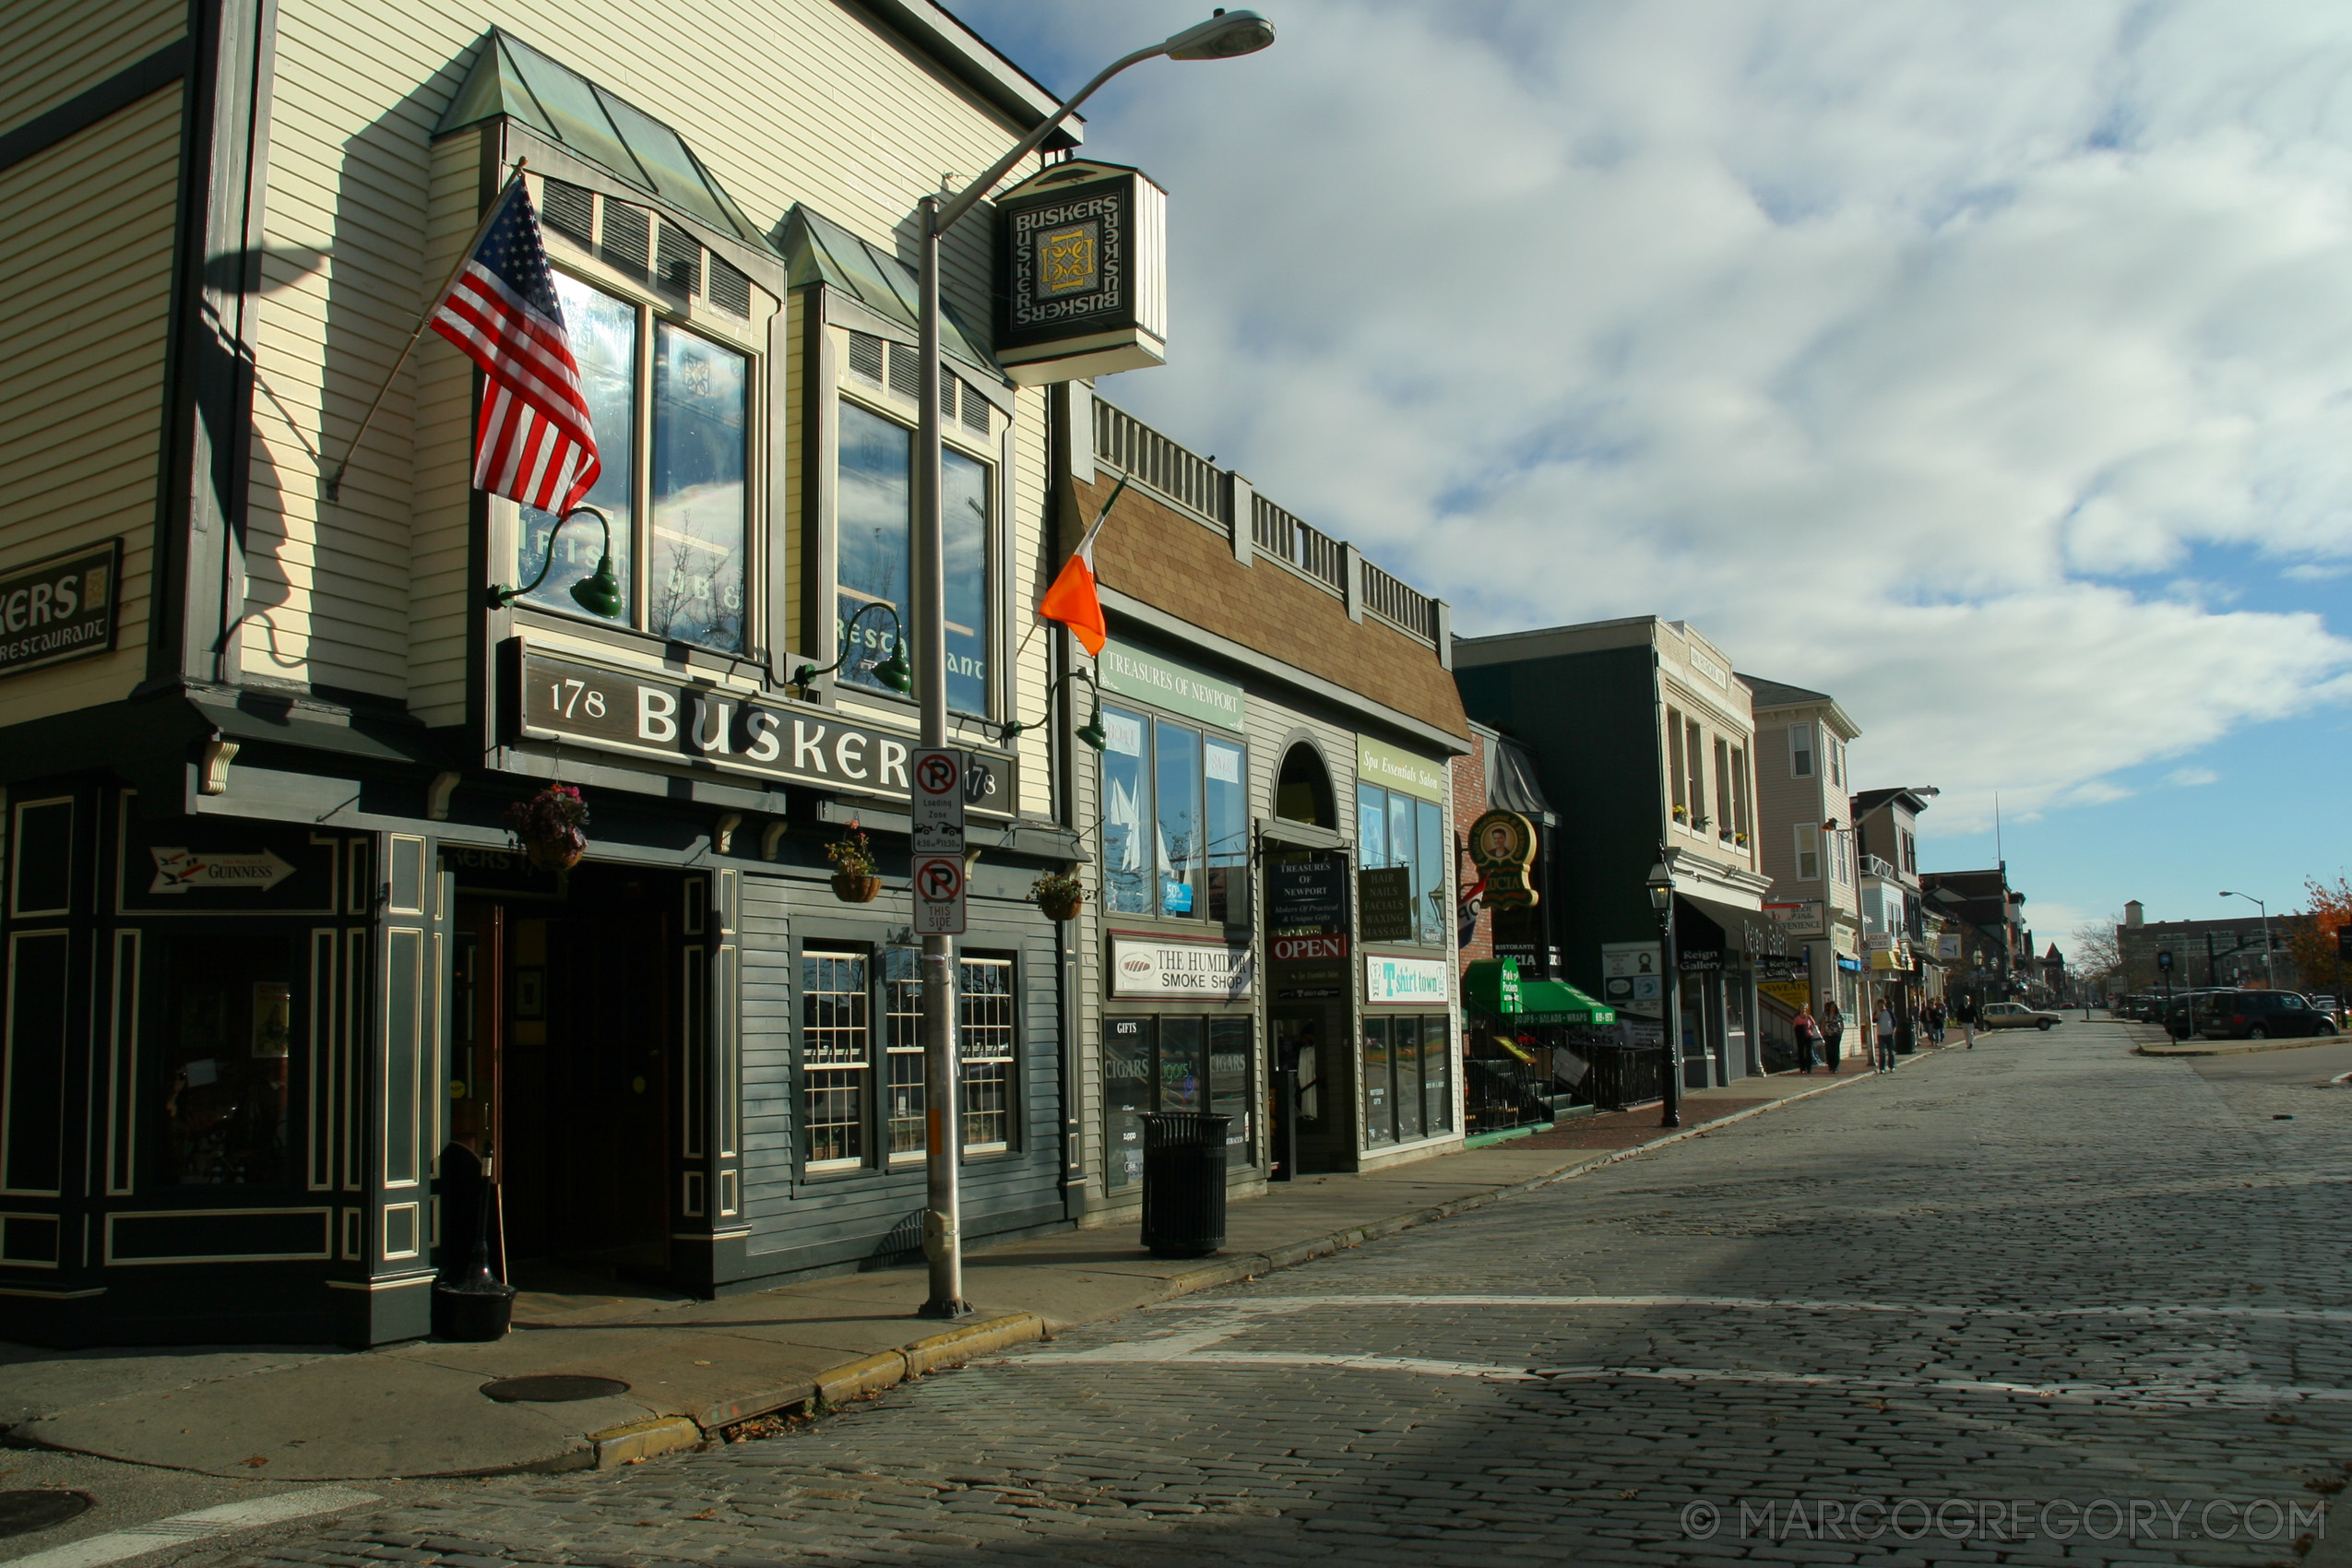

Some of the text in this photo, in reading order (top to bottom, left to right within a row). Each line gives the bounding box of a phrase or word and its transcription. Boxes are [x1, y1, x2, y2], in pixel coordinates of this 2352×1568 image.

[1016, 196, 1118, 232] BUSKERS
[0, 576, 78, 635] ERS
[1107, 650, 1238, 713] TREASURES OF NEWPORT
[551, 678, 996, 796] 178 BUSKER 178
[1108, 723, 1135, 744] BOAT
[1212, 754, 1232, 773] SALE
[1363, 750, 1438, 790] Spa Essentials Salon
[923, 799, 952, 808] Loading
[208, 863, 272, 878] GUINNESS
[1280, 862, 1331, 873] TREASURES
[1299, 875, 1313, 884] OF
[1372, 873, 1394, 884] HAIR
[1284, 886, 1328, 897] NEWPORT
[1369, 886, 1398, 897] NAILS
[929, 906, 950, 916] THIS
[1365, 899, 1404, 911] FACIALS
[929, 917, 951, 927] SIDE
[1365, 913, 1404, 924] WAXING
[1362, 926, 1408, 937] MASSAGE
[1744, 919, 1764, 960] Reign
[1275, 938, 1340, 959] OPEN
[1683, 950, 1717, 960] Reign
[1157, 949, 1246, 973] THE HUMIDOR
[1680, 961, 1723, 970] Gallery
[1162, 972, 1242, 989] SMOKE SHOP
[1383, 962, 1438, 997] T shirt town
[1117, 1022, 1137, 1034] GIFTS
[1105, 1058, 1149, 1079] CIGARS
[1209, 1054, 1246, 1073] CIGARS
